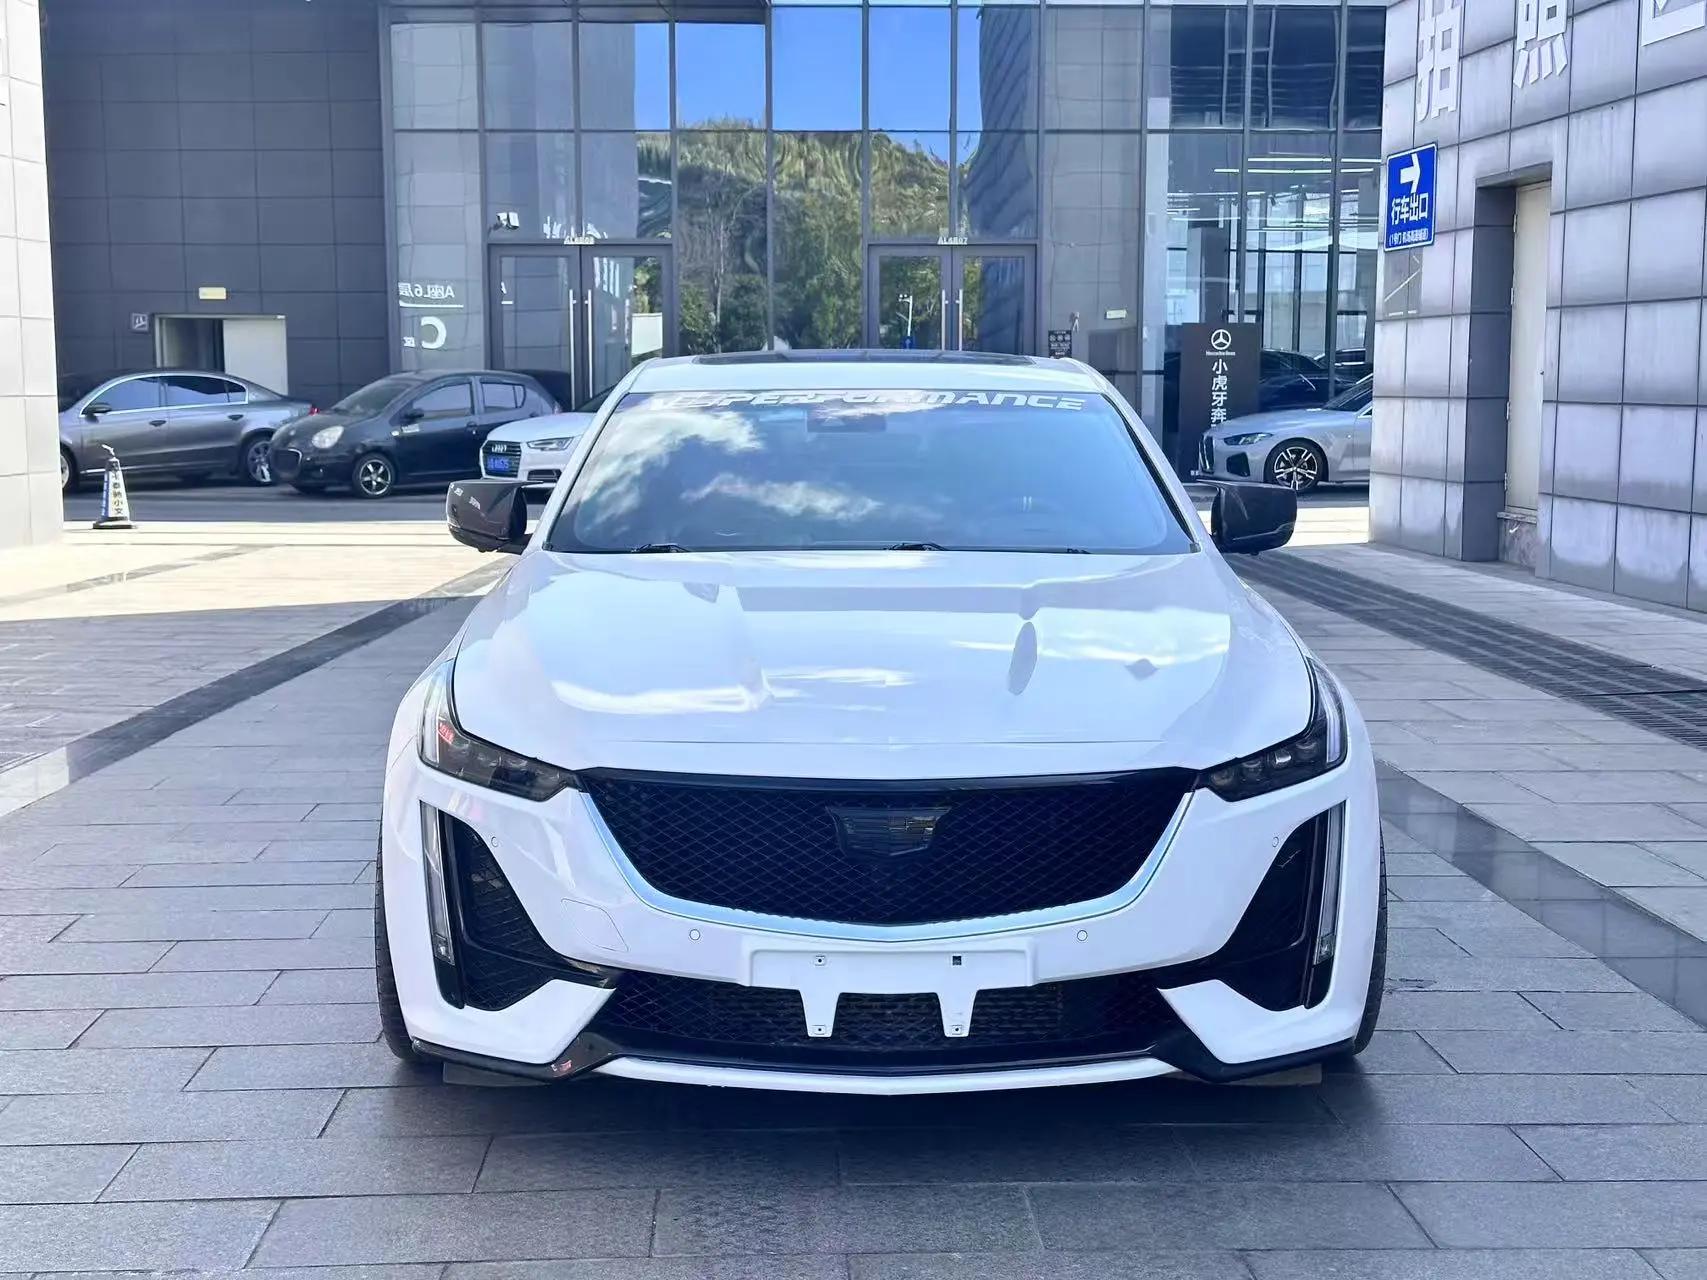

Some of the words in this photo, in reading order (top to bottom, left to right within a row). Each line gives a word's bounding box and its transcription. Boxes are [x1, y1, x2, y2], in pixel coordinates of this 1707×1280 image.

[1391, 193, 1429, 225] 行车出口
[1211, 358, 1228, 427] 小虎牙奔
